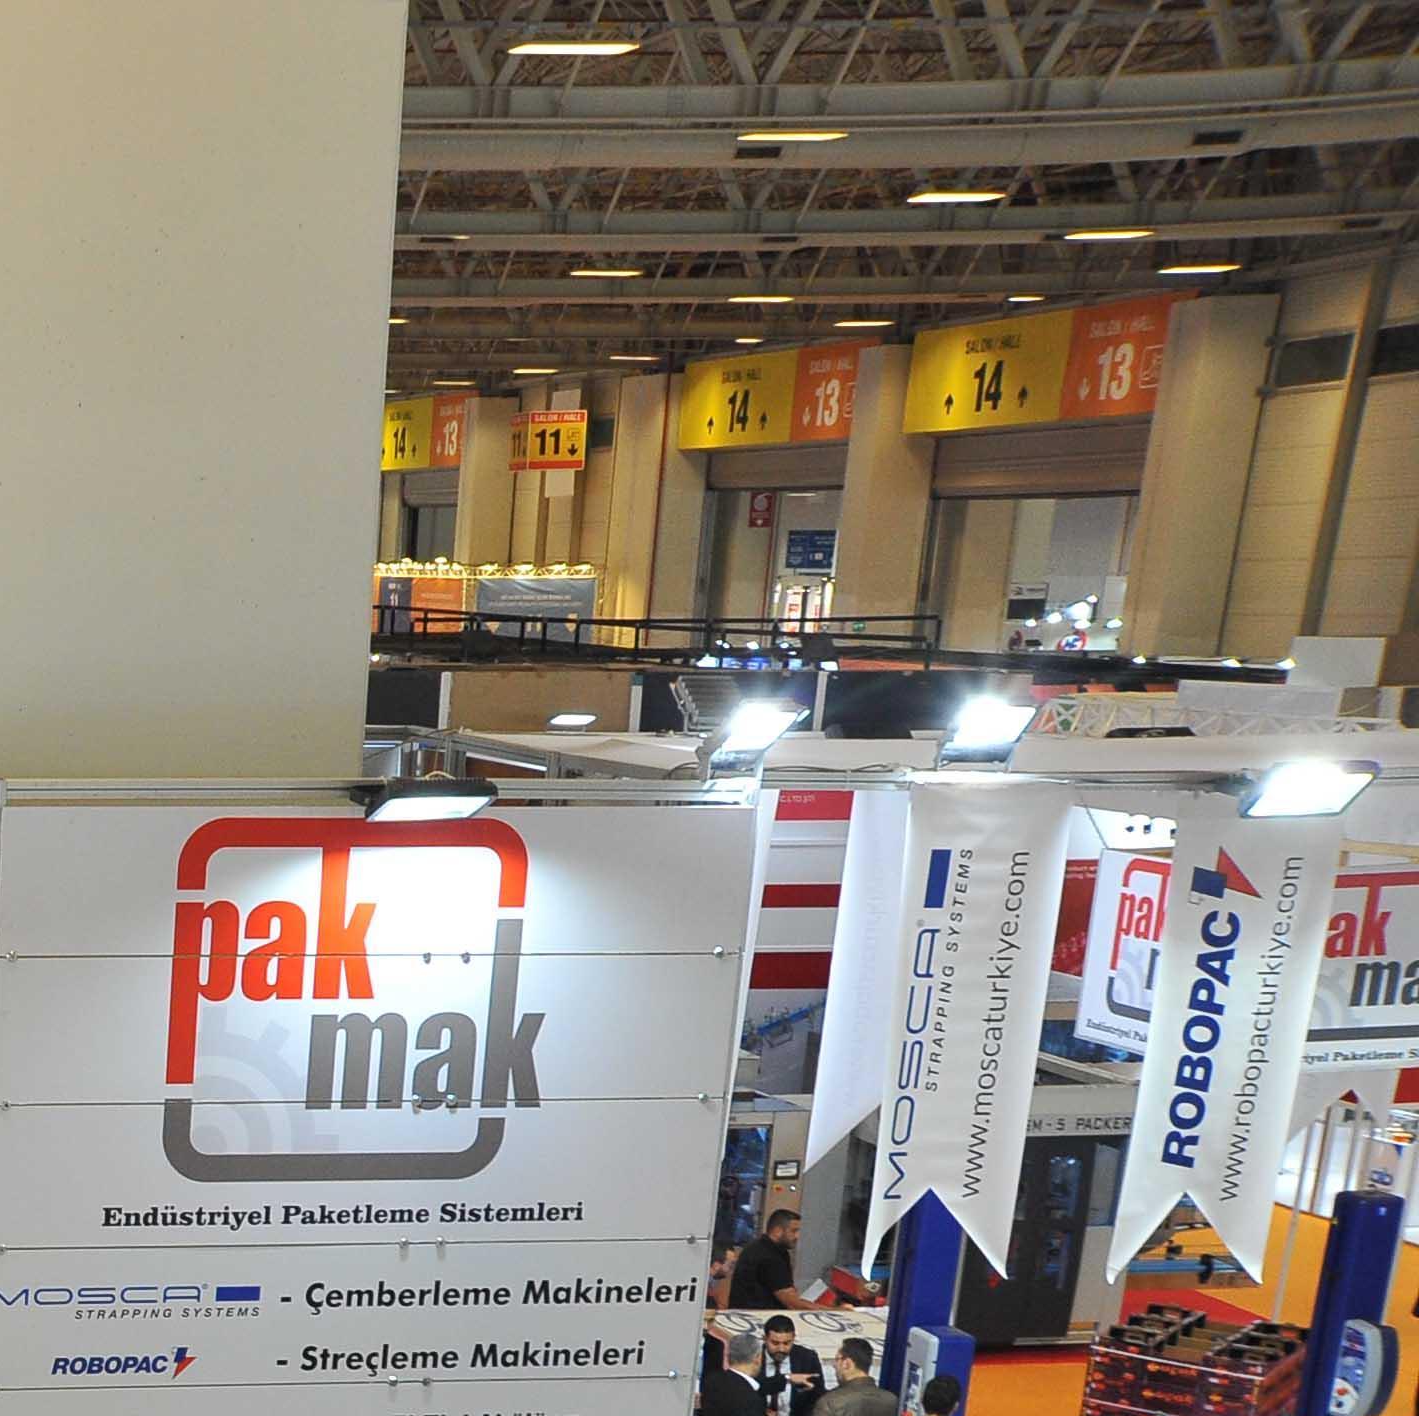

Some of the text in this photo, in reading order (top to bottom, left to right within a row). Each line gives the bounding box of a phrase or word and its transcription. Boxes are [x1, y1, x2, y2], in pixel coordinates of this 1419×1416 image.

[973, 360, 1005, 413] 14
[1098, 343, 1135, 400] 13
[534, 413, 558, 422] SALON
[728, 389, 751, 433] 14
[815, 379, 840, 427] 13
[393, 427, 408, 459] 14
[444, 420, 458, 457] 13
[534, 428, 561, 456] 11
[173, 846, 376, 1040] pak
[925, 848, 974, 1092] STRAPPING SYSTEMS
[304, 940, 545, 1111] mak
[962, 850, 1031, 1199] www.moscaturkiye.com
[1162, 911, 1241, 1168] ROBOPAC
[1221, 856, 1303, 1202] www.robopacturkiye.com
[883, 927, 942, 1202] MOSCA
[1076, 1117, 1132, 1131] PACKER
[102, 1201, 584, 1231] Endüstriyel Paketleme Sistemleri
[74, 1306, 261, 1320] STRAPPING SYSTEMS
[303, 1278, 699, 1317] Çemberleme Makineleri
[51, 1355, 168, 1376] ROBOPAC
[300, 1341, 645, 1377] Streçleme Makineleri
